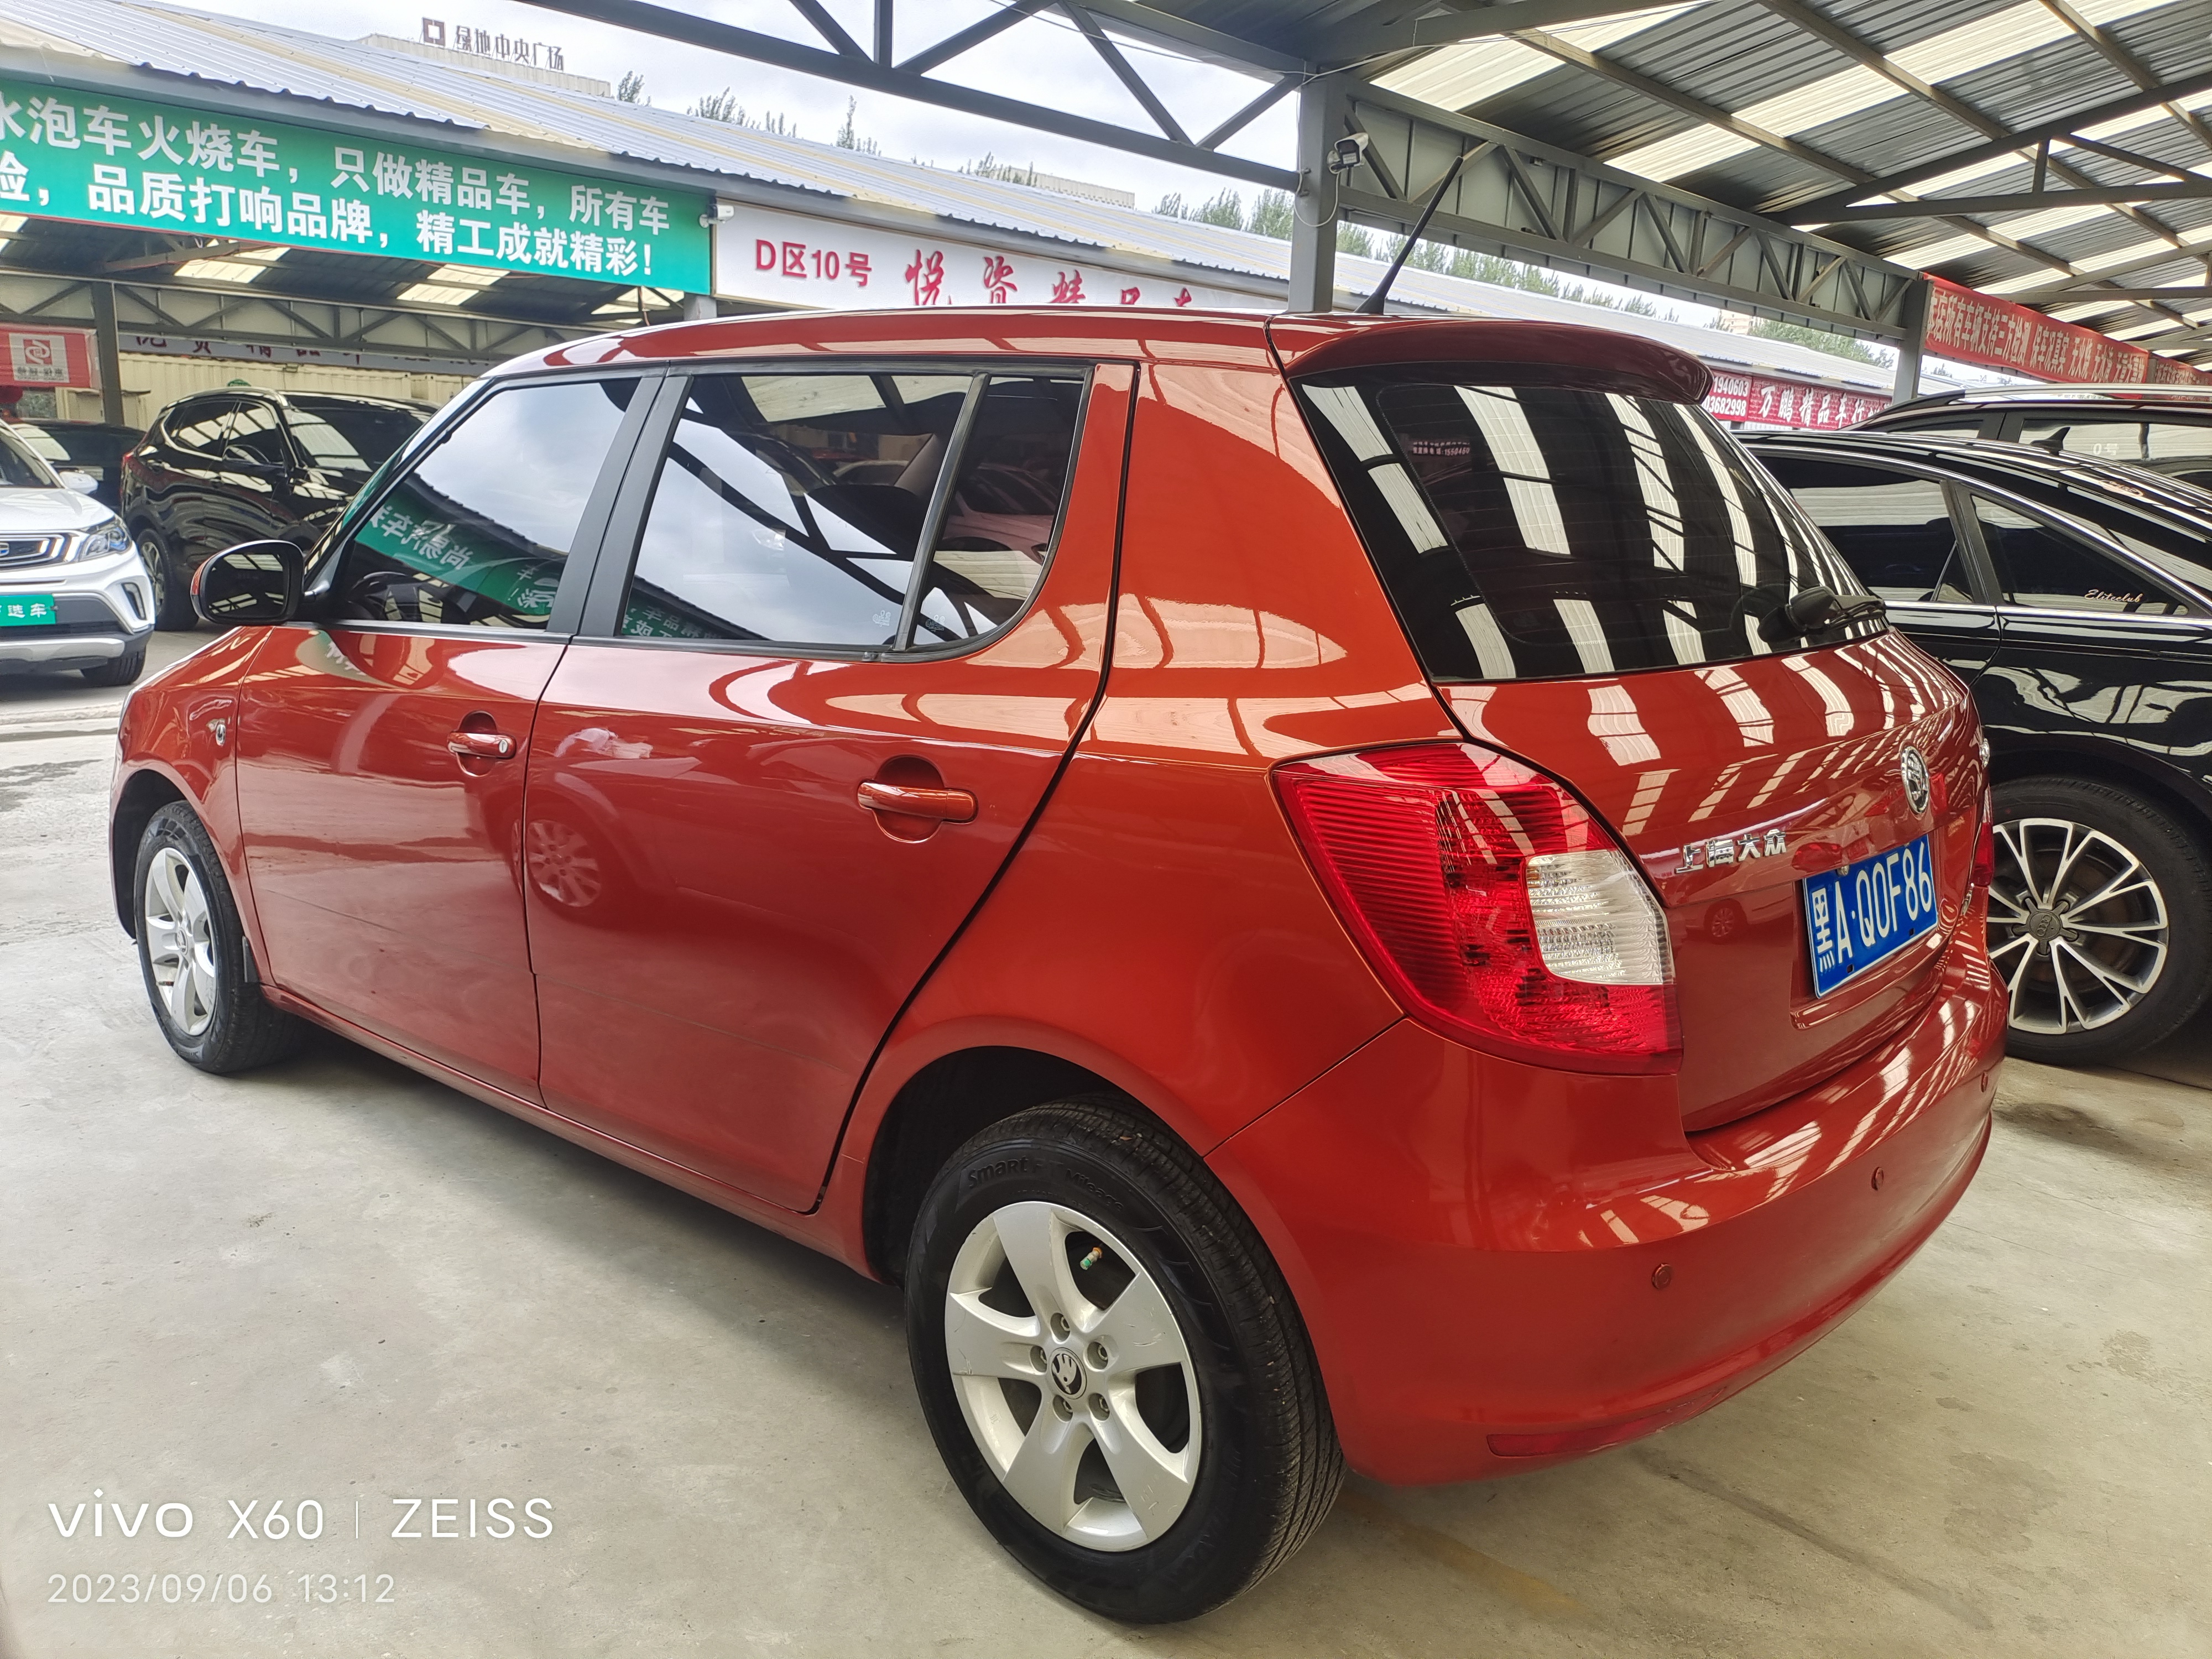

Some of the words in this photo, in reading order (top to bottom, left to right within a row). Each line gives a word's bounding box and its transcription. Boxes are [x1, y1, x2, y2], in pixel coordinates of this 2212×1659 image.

[455, 25, 564, 71] 绿地中央广场
[755, 238, 872, 287] D区10号
[1713, 376, 1749, 397] 1940603
[1702, 395, 1747, 416] 03682998
[2084, 589, 2143, 603] Eliteclub
[0, 603, 47, 618] 选车
[1674, 828, 1787, 874] 上海大众
